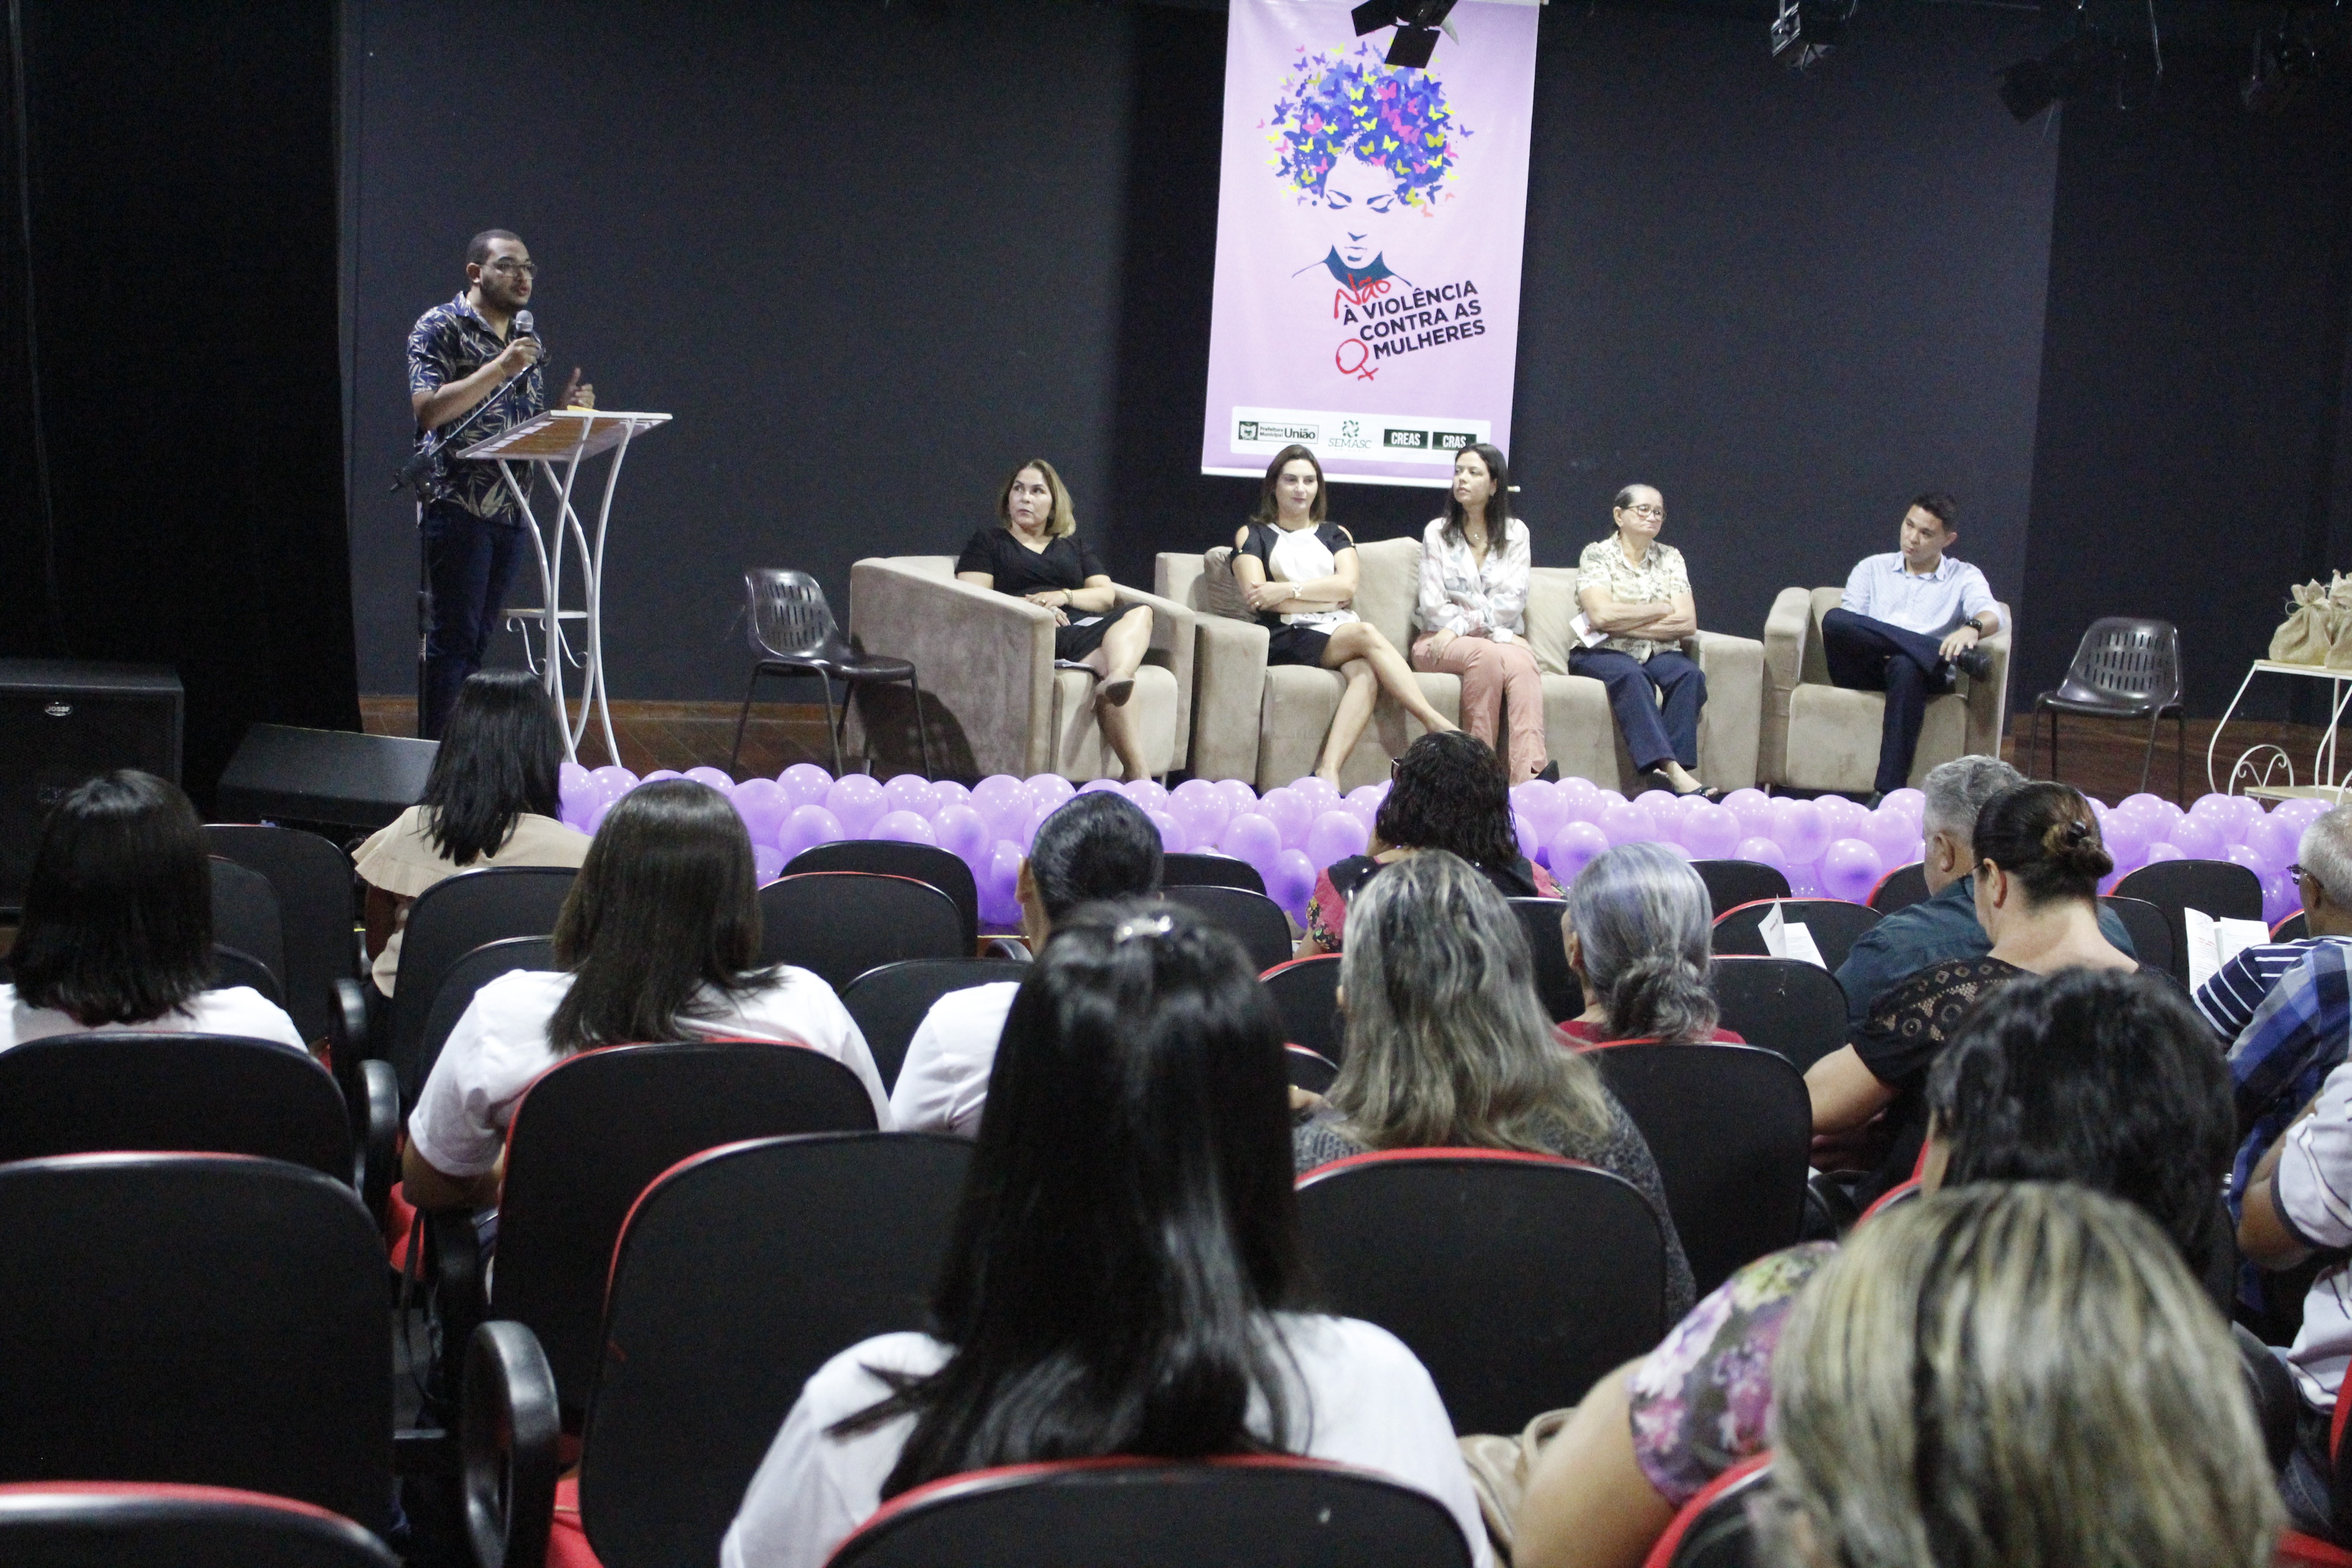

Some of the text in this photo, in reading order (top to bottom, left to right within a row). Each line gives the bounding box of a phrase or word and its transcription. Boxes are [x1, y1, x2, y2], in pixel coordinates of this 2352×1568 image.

[1334, 273, 1391, 319] Não
[1343, 280, 1478, 326] À VIOLÊNCIA
[1360, 299, 1482, 341] CONTRA AS
[1373, 319, 1486, 359] MULHERES
[1284, 428, 1316, 439] União
[1328, 438, 1372, 449] SEMASC
[1391, 431, 1421, 446] CREAS
[1442, 435, 1467, 448] CRAS
